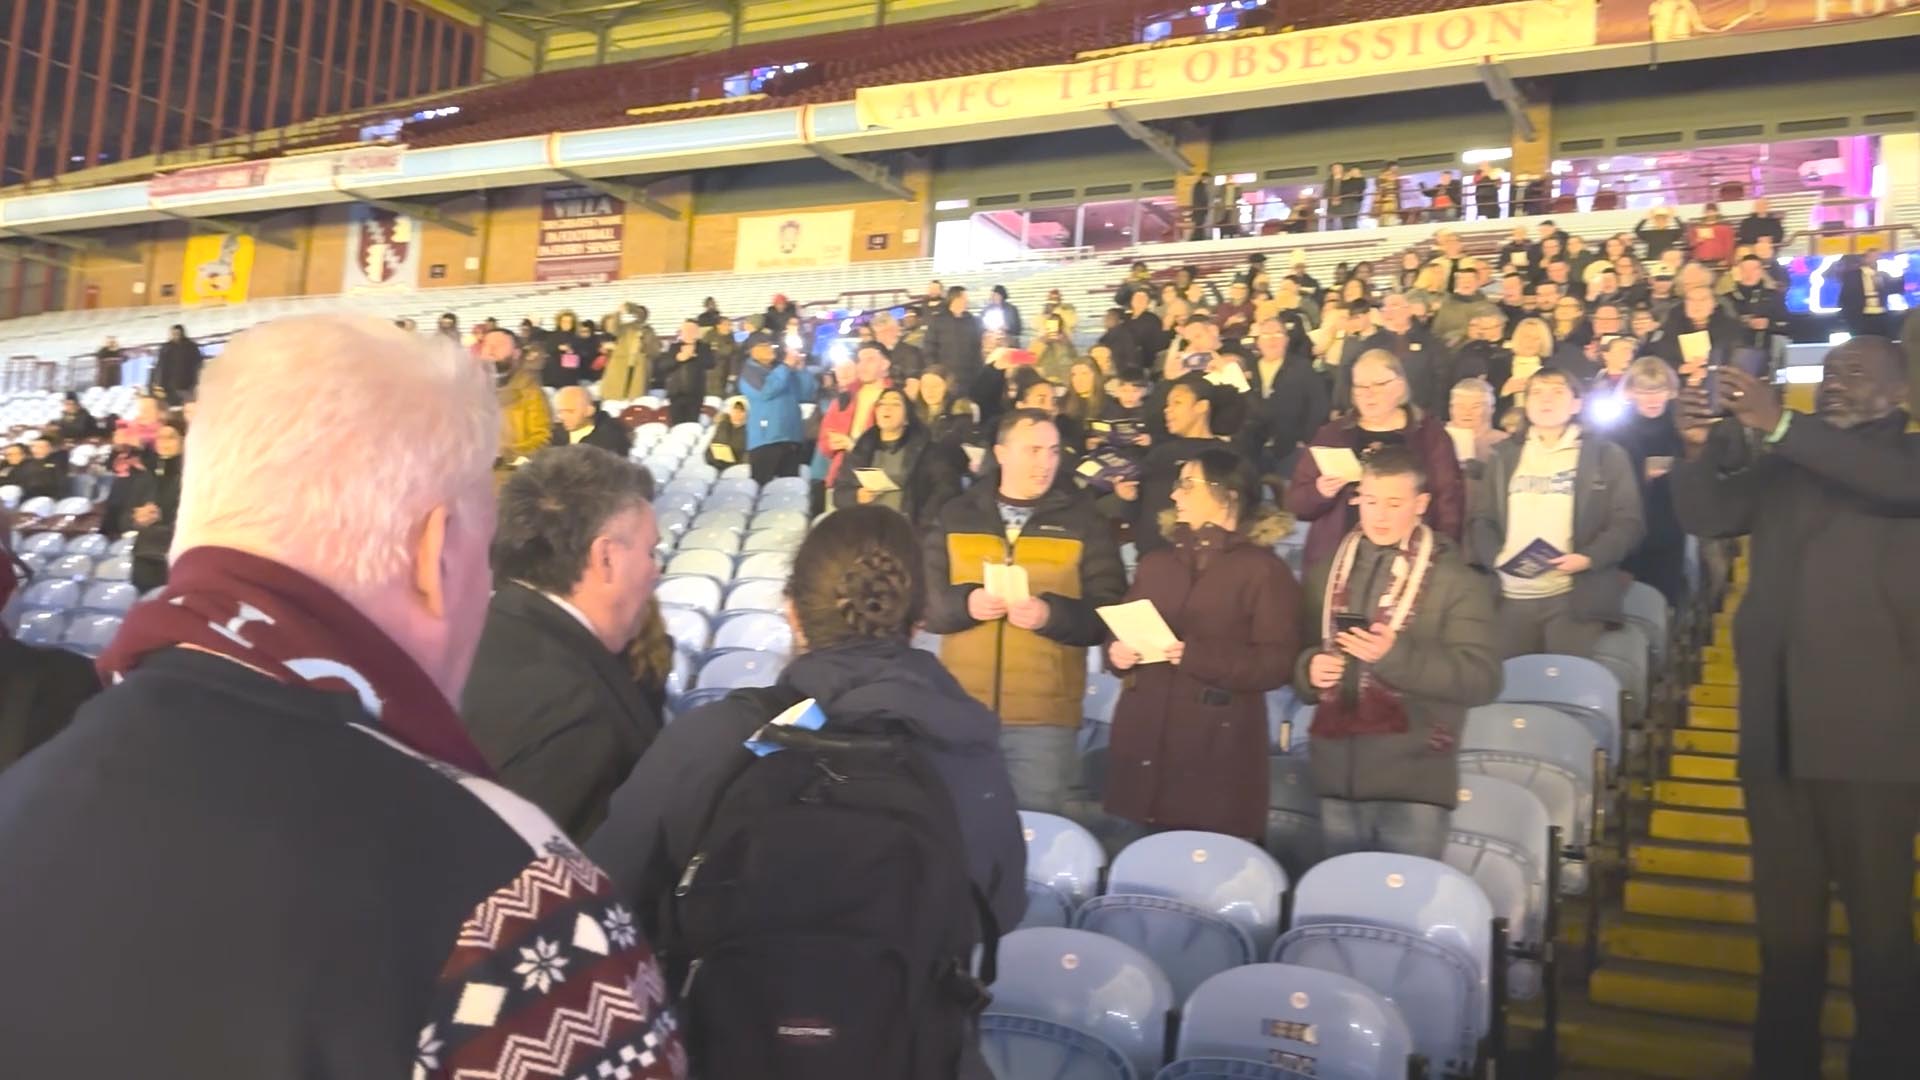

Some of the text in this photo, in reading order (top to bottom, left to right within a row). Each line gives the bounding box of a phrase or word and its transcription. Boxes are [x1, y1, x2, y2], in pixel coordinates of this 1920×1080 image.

[896, 8, 1524, 119] AVFC THE OBSESSION
